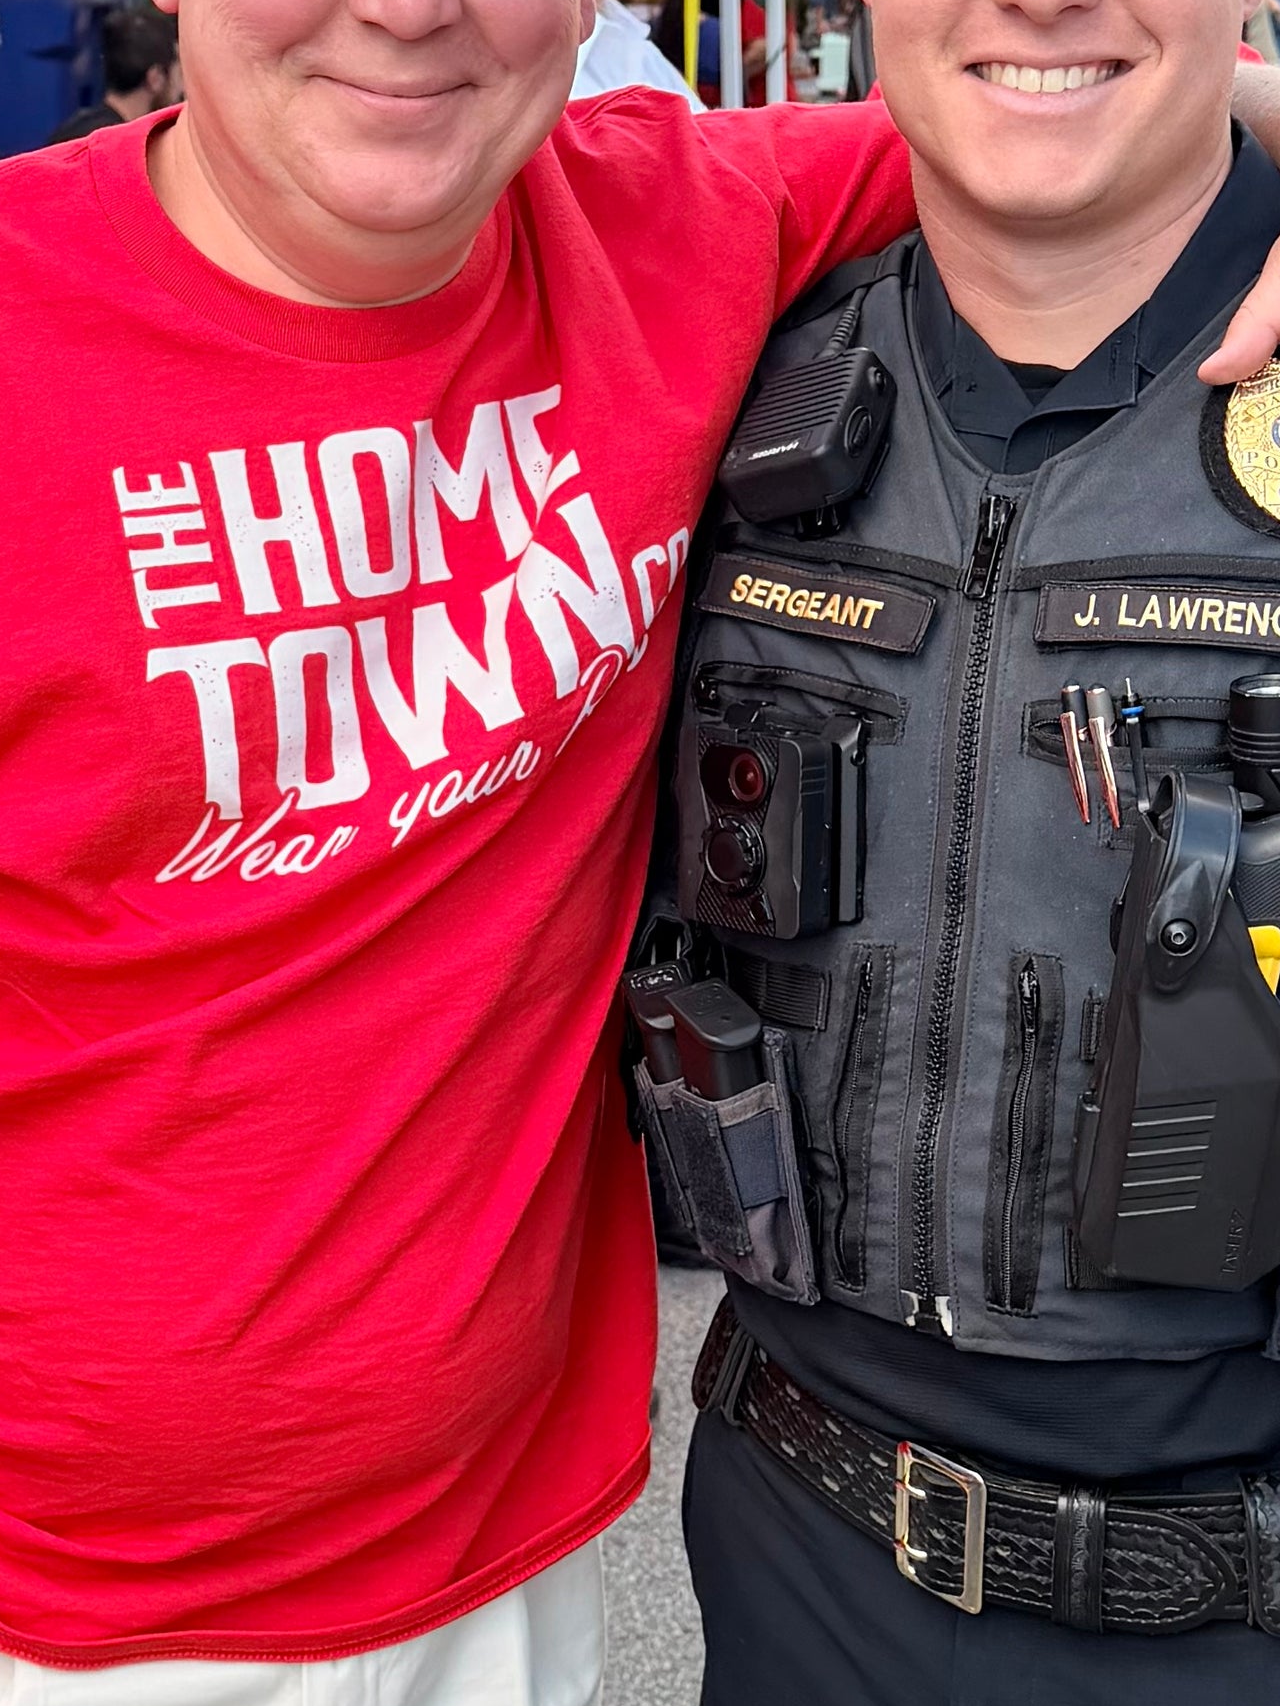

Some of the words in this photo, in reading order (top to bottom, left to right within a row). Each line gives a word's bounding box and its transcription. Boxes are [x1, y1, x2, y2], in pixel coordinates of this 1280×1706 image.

[113, 461, 221, 629] THE
[208, 384, 581, 616] HOME
[145, 492, 635, 820] TOWN
[728, 573, 885, 631] SERGEANT
[1073, 593, 1101, 627] J.
[154, 786, 360, 883] Wear
[388, 738, 542, 849] your
